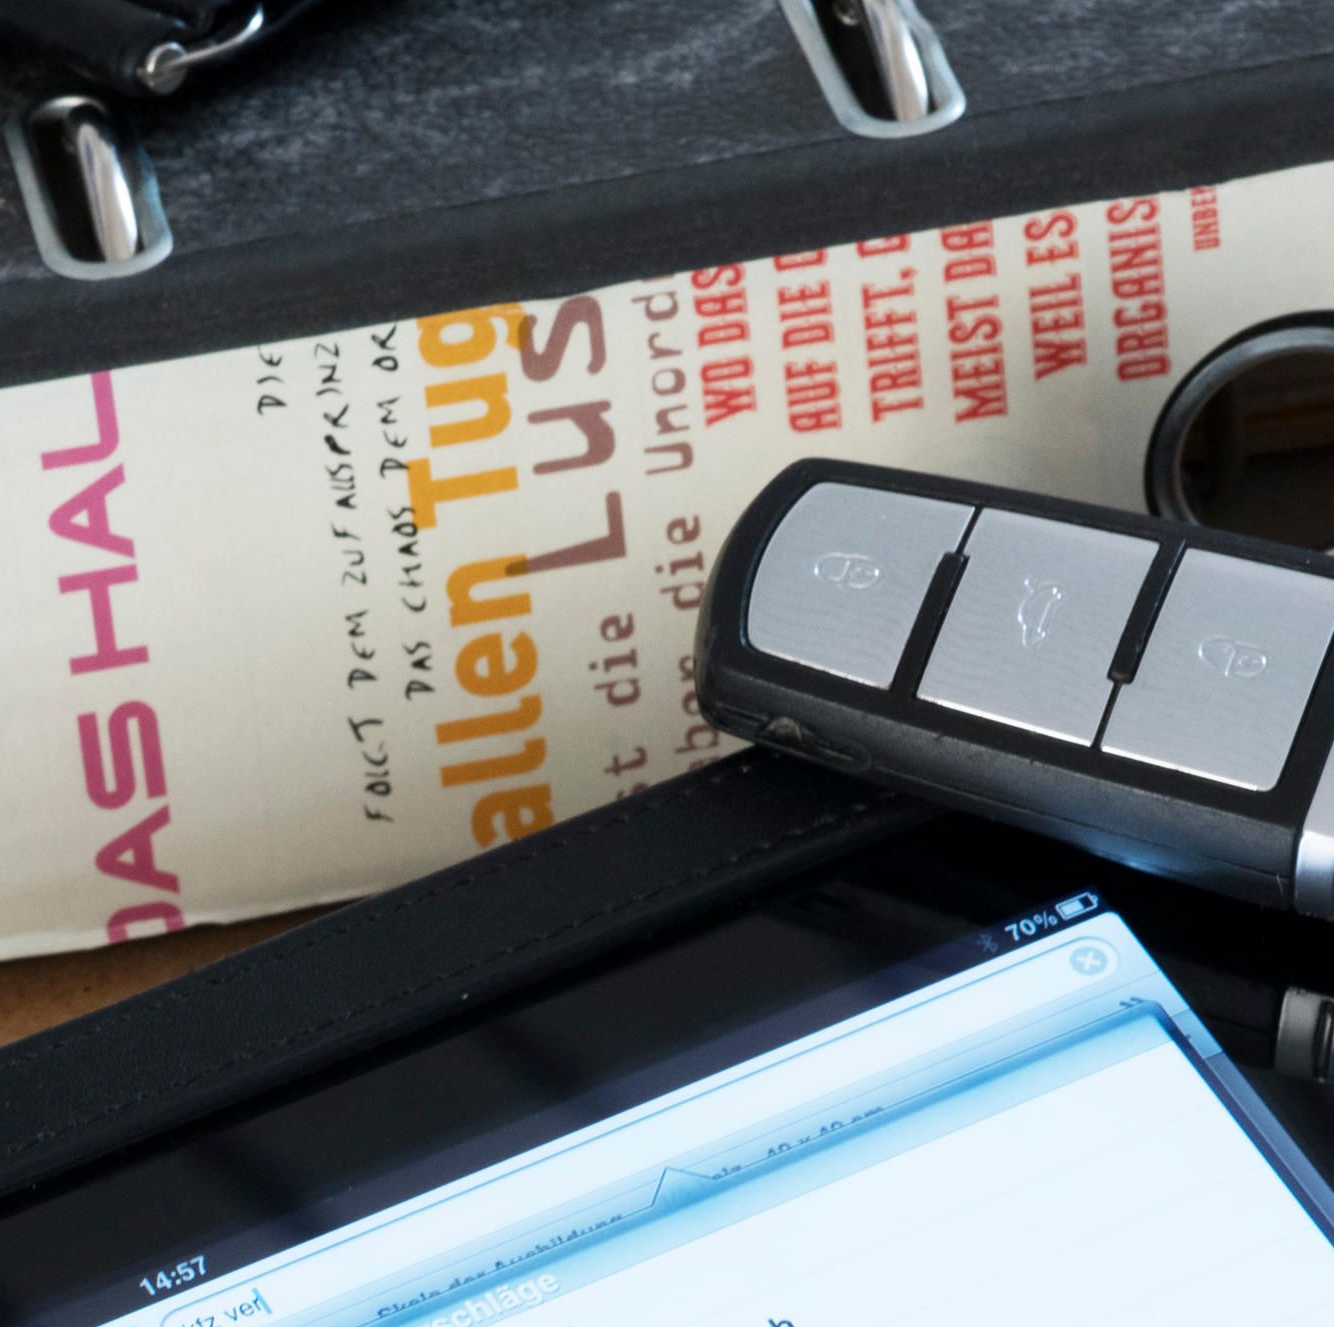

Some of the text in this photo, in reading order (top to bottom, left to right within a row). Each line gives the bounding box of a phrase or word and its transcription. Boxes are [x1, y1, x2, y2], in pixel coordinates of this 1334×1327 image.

[776, 278, 835, 351] DIE
[1024, 208, 1088, 381] WEIL ES
[1106, 195, 1171, 384] ORGANIS
[690, 262, 758, 428] WO DAS
[860, 265, 925, 424] TRIFFT,
[946, 294, 1008, 424] MEIST
[379, 395, 412, 479] DEM
[505, 294, 627, 577] Lus
[783, 360, 843, 434] AUF
[389, 504, 428, 613] CHAOS
[405, 302, 555, 850] allen Tug
[655, 512, 705, 611] die
[40, 371, 186, 944] DAS HAL
[345, 607, 377, 690] DEM
[405, 639, 436, 702] DAS
[589, 610, 643, 709] die
[1004, 911, 1058, 941] 70%
[138, 1255, 208, 1297] 14:57
[224, 1293, 263, 1322] ver
